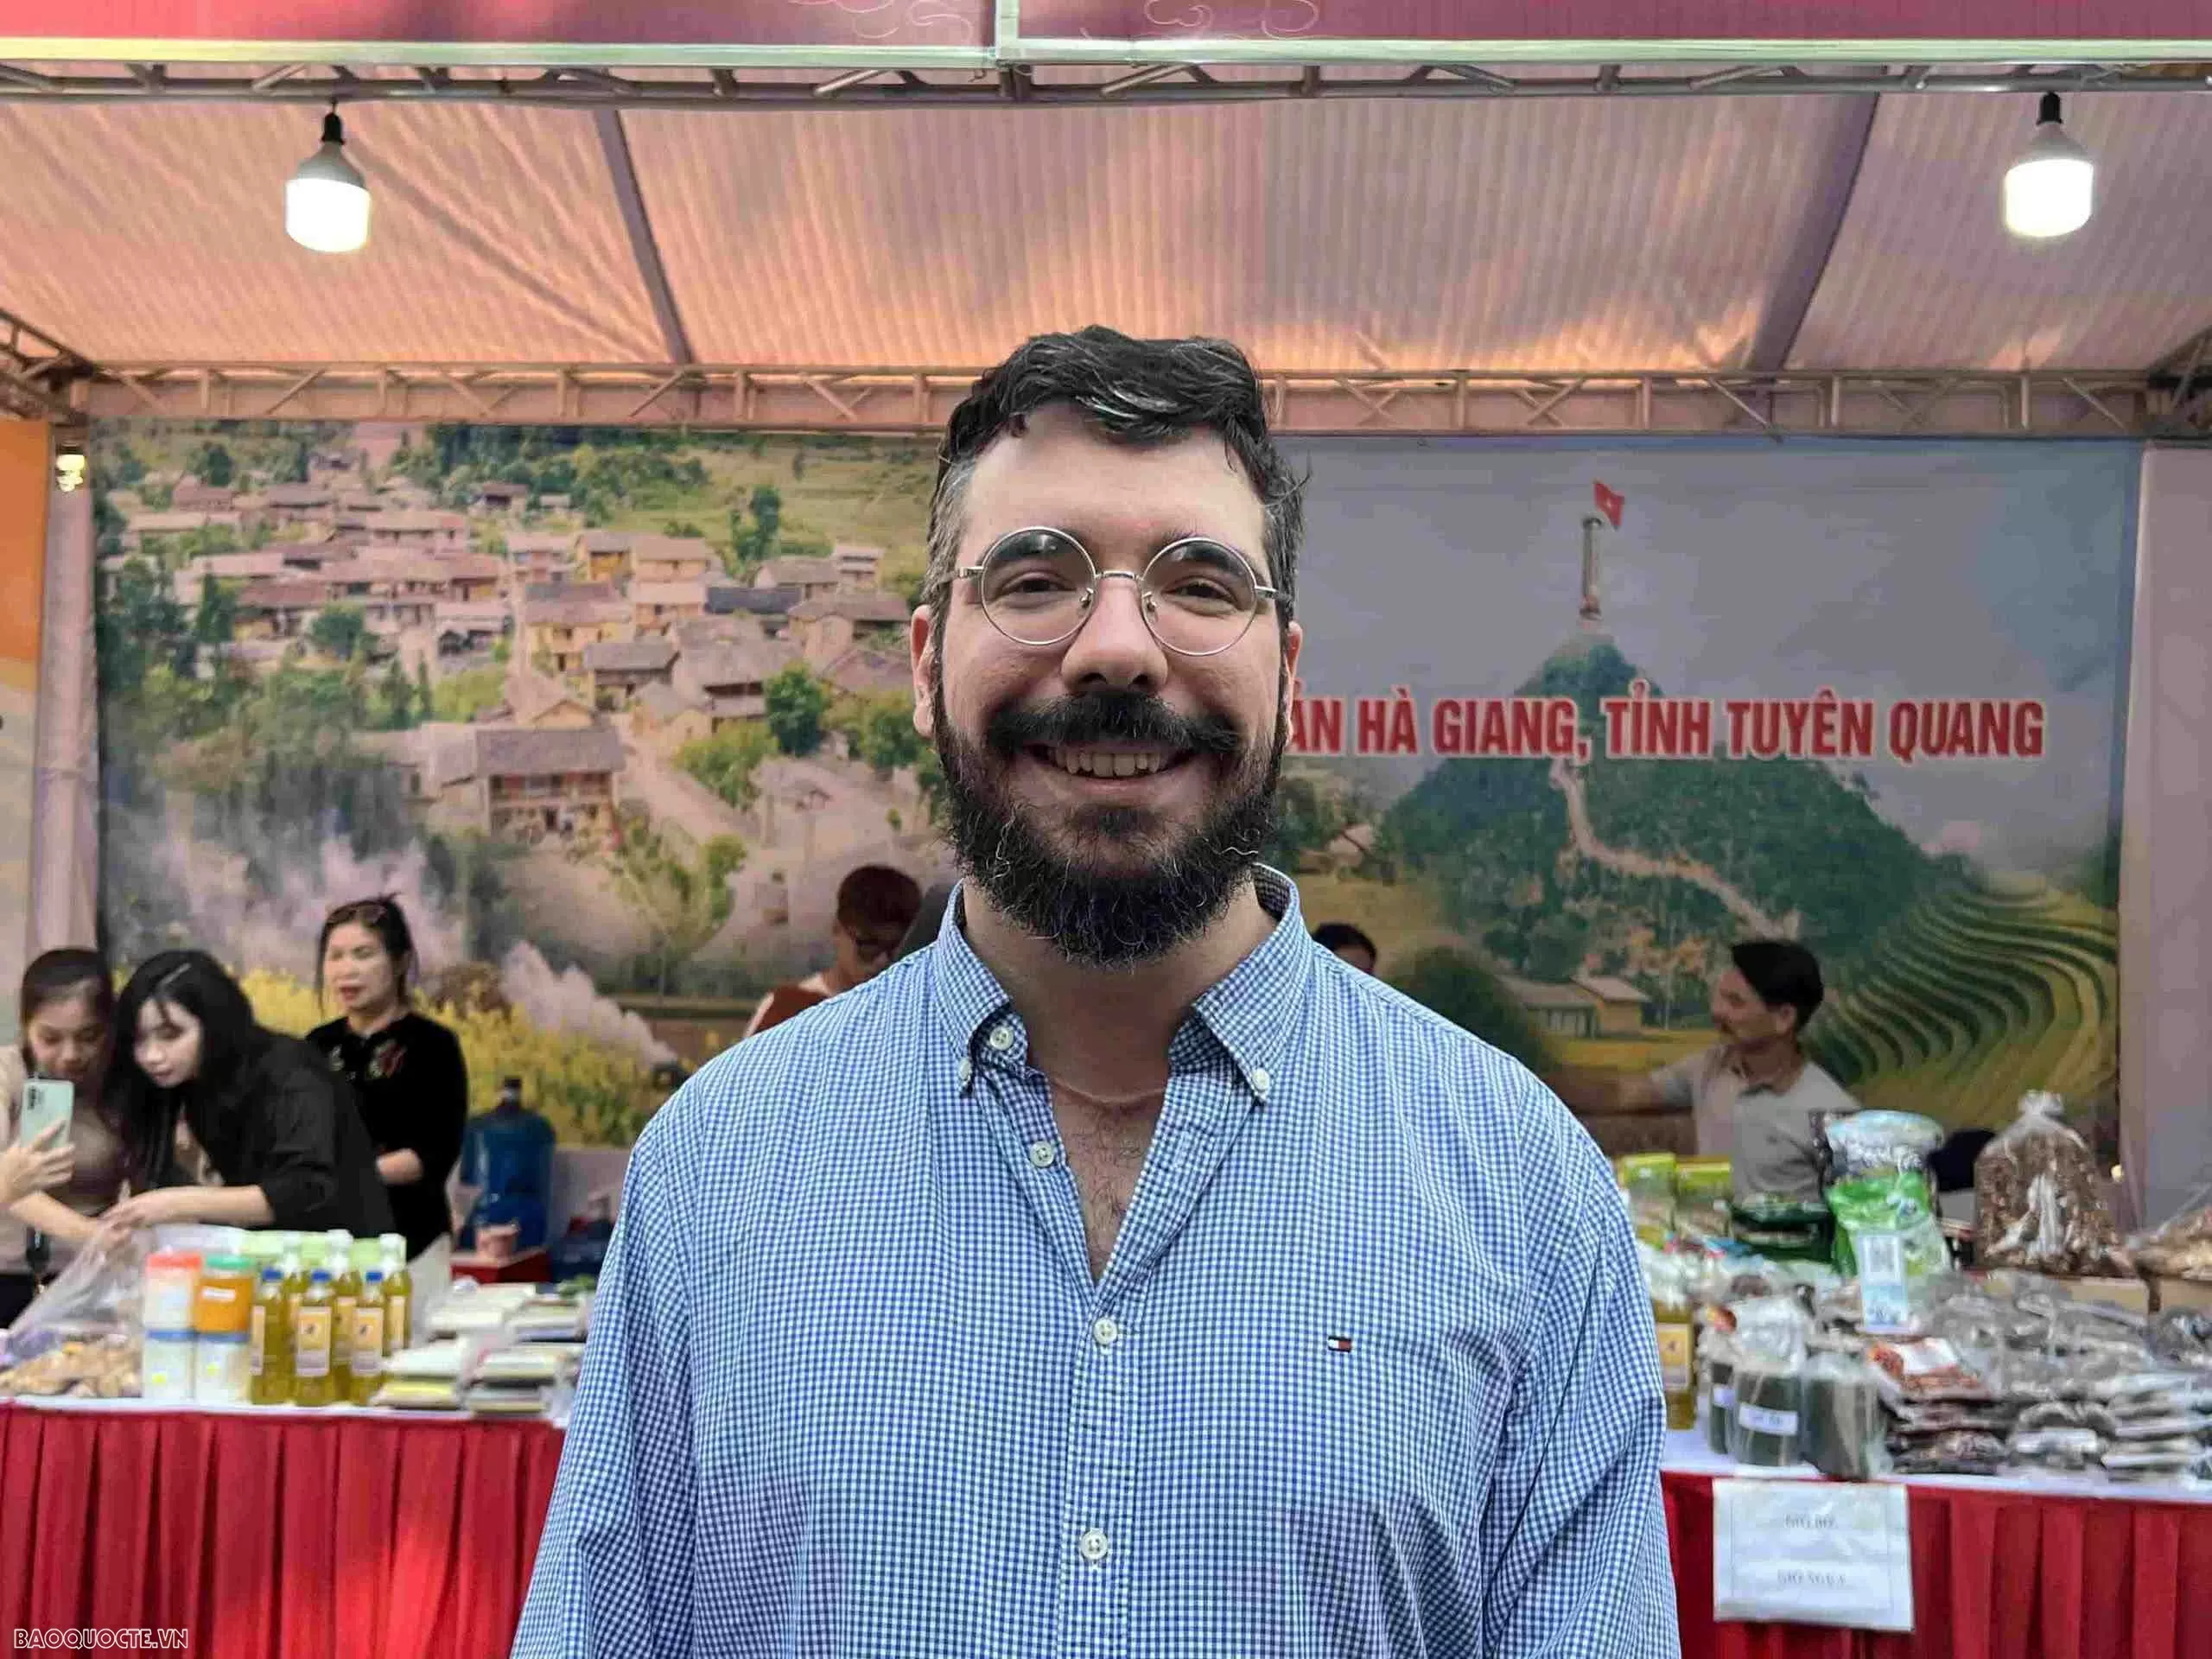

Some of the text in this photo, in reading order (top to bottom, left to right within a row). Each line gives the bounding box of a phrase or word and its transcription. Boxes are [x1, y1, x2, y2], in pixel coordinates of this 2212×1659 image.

[1357, 686, 1419, 754] HÀ
[1432, 698, 1588, 760] GIANG,
[1605, 679, 1710, 754] TỈNH
[1726, 688, 1873, 756] TUYÊN
[1889, 700, 2044, 761] QUANG
